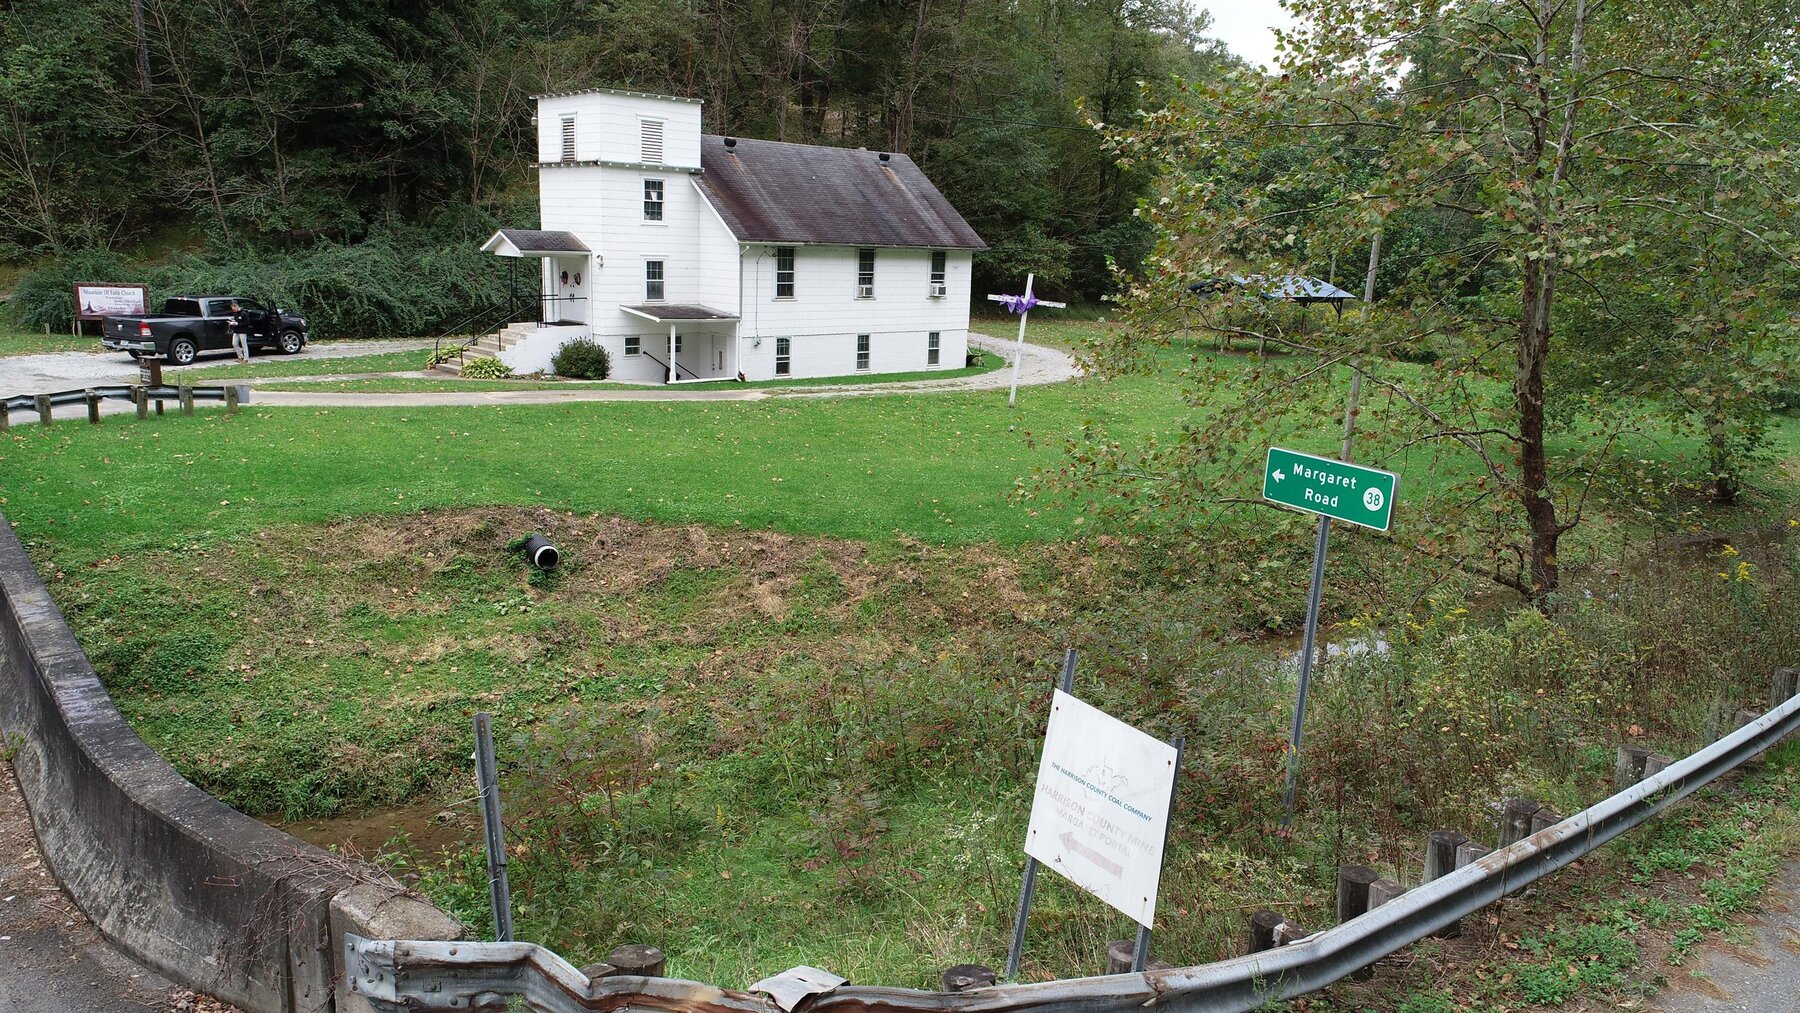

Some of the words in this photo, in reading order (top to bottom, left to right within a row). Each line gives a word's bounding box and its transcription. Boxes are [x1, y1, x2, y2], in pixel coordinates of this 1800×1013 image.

[1293, 463, 1357, 489] Margaret
[1304, 488, 1339, 507] Road
[1366, 492, 1381, 506] 38
[1051, 762, 1061, 772] THE
[1061, 768, 1086, 786] HARRISON
[1086, 782, 1108, 799] COUNTY
[1108, 795, 1123, 807] COAL
[1123, 803, 1153, 822] COMPANY
[1041, 784, 1086, 816] HARRISON
[1086, 811, 1127, 838] COUNTY
[1127, 834, 1156, 856] MINE
[1099, 832, 1132, 857] PORTAL
